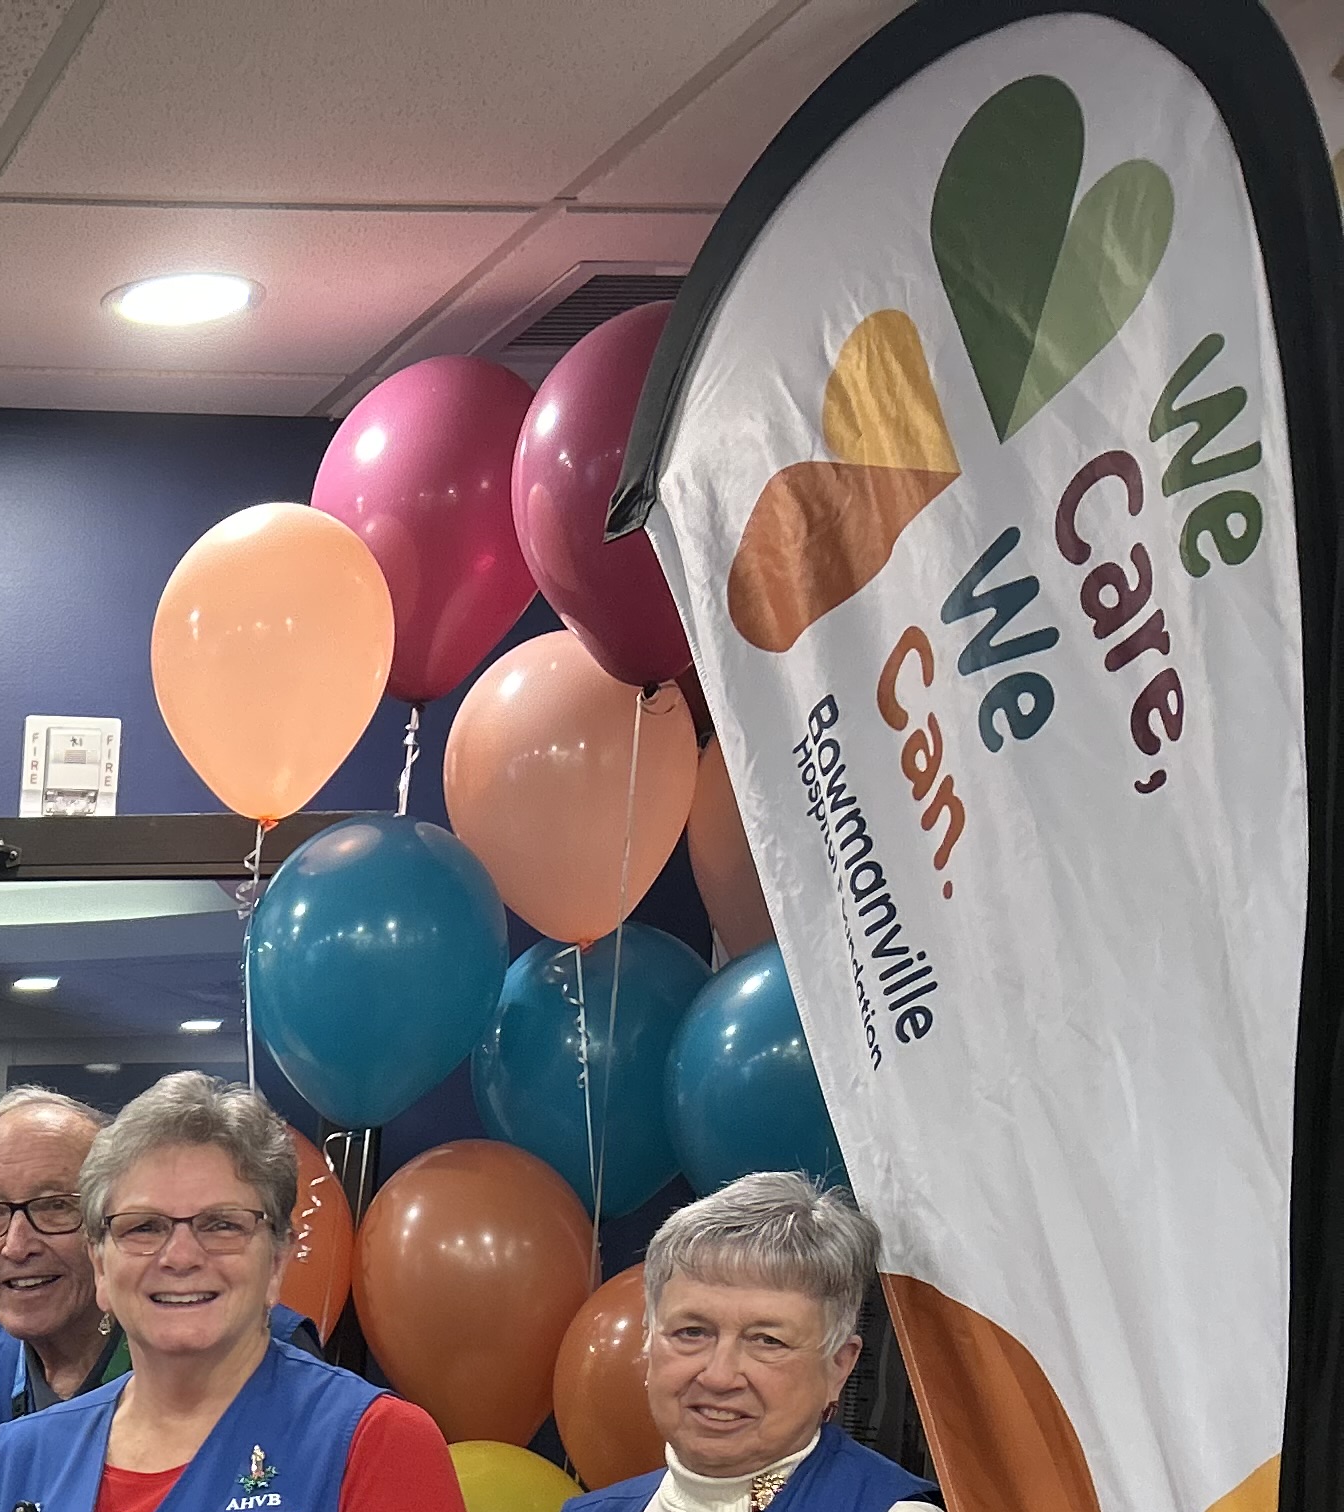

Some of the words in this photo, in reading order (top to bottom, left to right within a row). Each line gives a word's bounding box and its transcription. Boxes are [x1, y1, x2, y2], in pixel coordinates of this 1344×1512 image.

[1148, 333, 1263, 577] We
[939, 526, 1060, 753] We
[1055, 449, 1184, 795] Care,
[30, 732, 40, 784] FIRE
[104, 735, 114, 787] FIRE
[808, 693, 939, 1044] Bowmanville
[876, 626, 967, 900] Can.
[225, 1492, 282, 1511] AHVB
